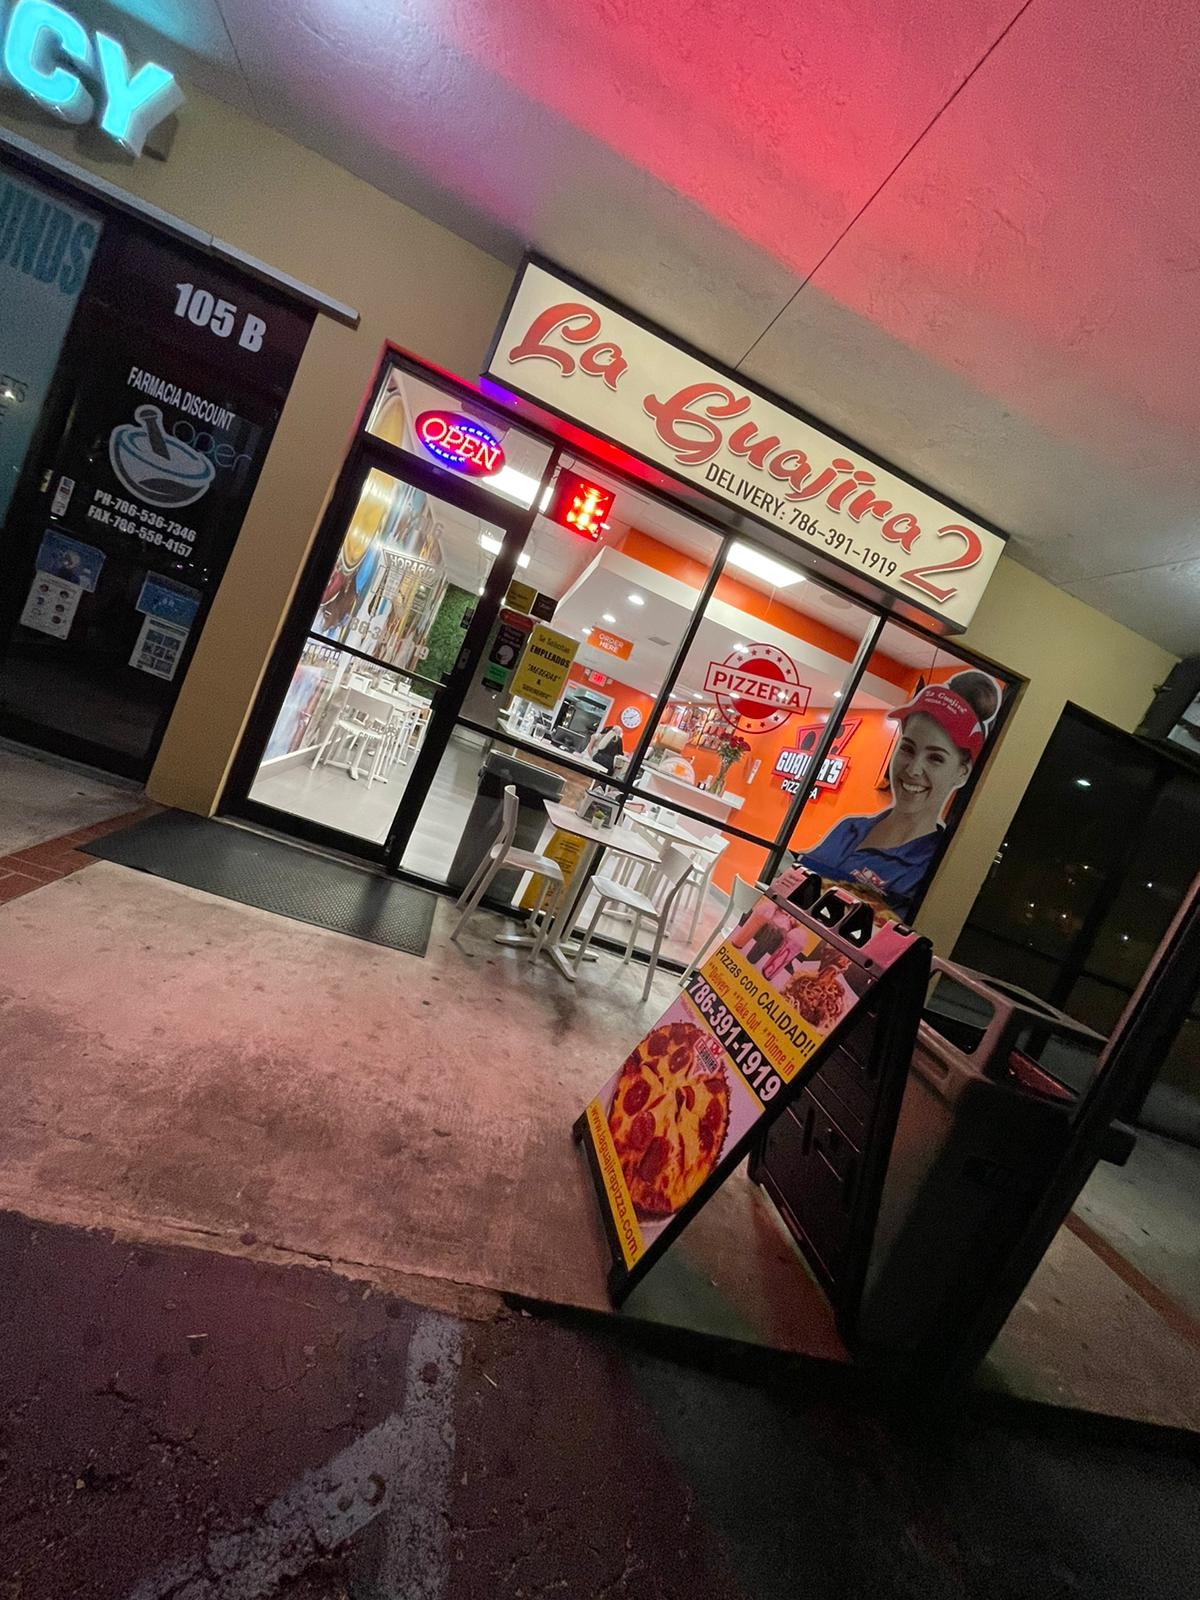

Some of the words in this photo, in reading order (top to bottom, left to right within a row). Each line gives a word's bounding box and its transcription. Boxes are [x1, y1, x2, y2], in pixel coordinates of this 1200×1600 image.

[174, 282, 238, 338] 105
[238, 313, 268, 353] B
[127, 366, 183, 408] FARMACIA
[180, 391, 236, 431] DISCOUNT
[421, 417, 501, 471] OPEN
[508, 303, 629, 391] La
[643, 383, 922, 556] Guajira
[900, 524, 983, 603] 2
[87, 504, 193, 558] FAX-786-558-4157
[94, 489, 197, 543] PH-786-536-7346
[705, 462, 786, 522] DELIVERY:
[787, 507, 899, 579] 786-391-1919
[529, 644, 571, 669] EMPLEADOS
[712, 670, 801, 708] PIZZERIA
[775, 751, 844, 784] GUAJIA'S
[781, 779, 818, 800] PIZZA
[716, 946, 742, 978] Pizzas
[740, 975, 759, 997] con
[757, 991, 816, 1057] CALIDAD!!
[689, 976, 781, 1102] 786-391-1919
[783, 1057, 796, 1076] in
